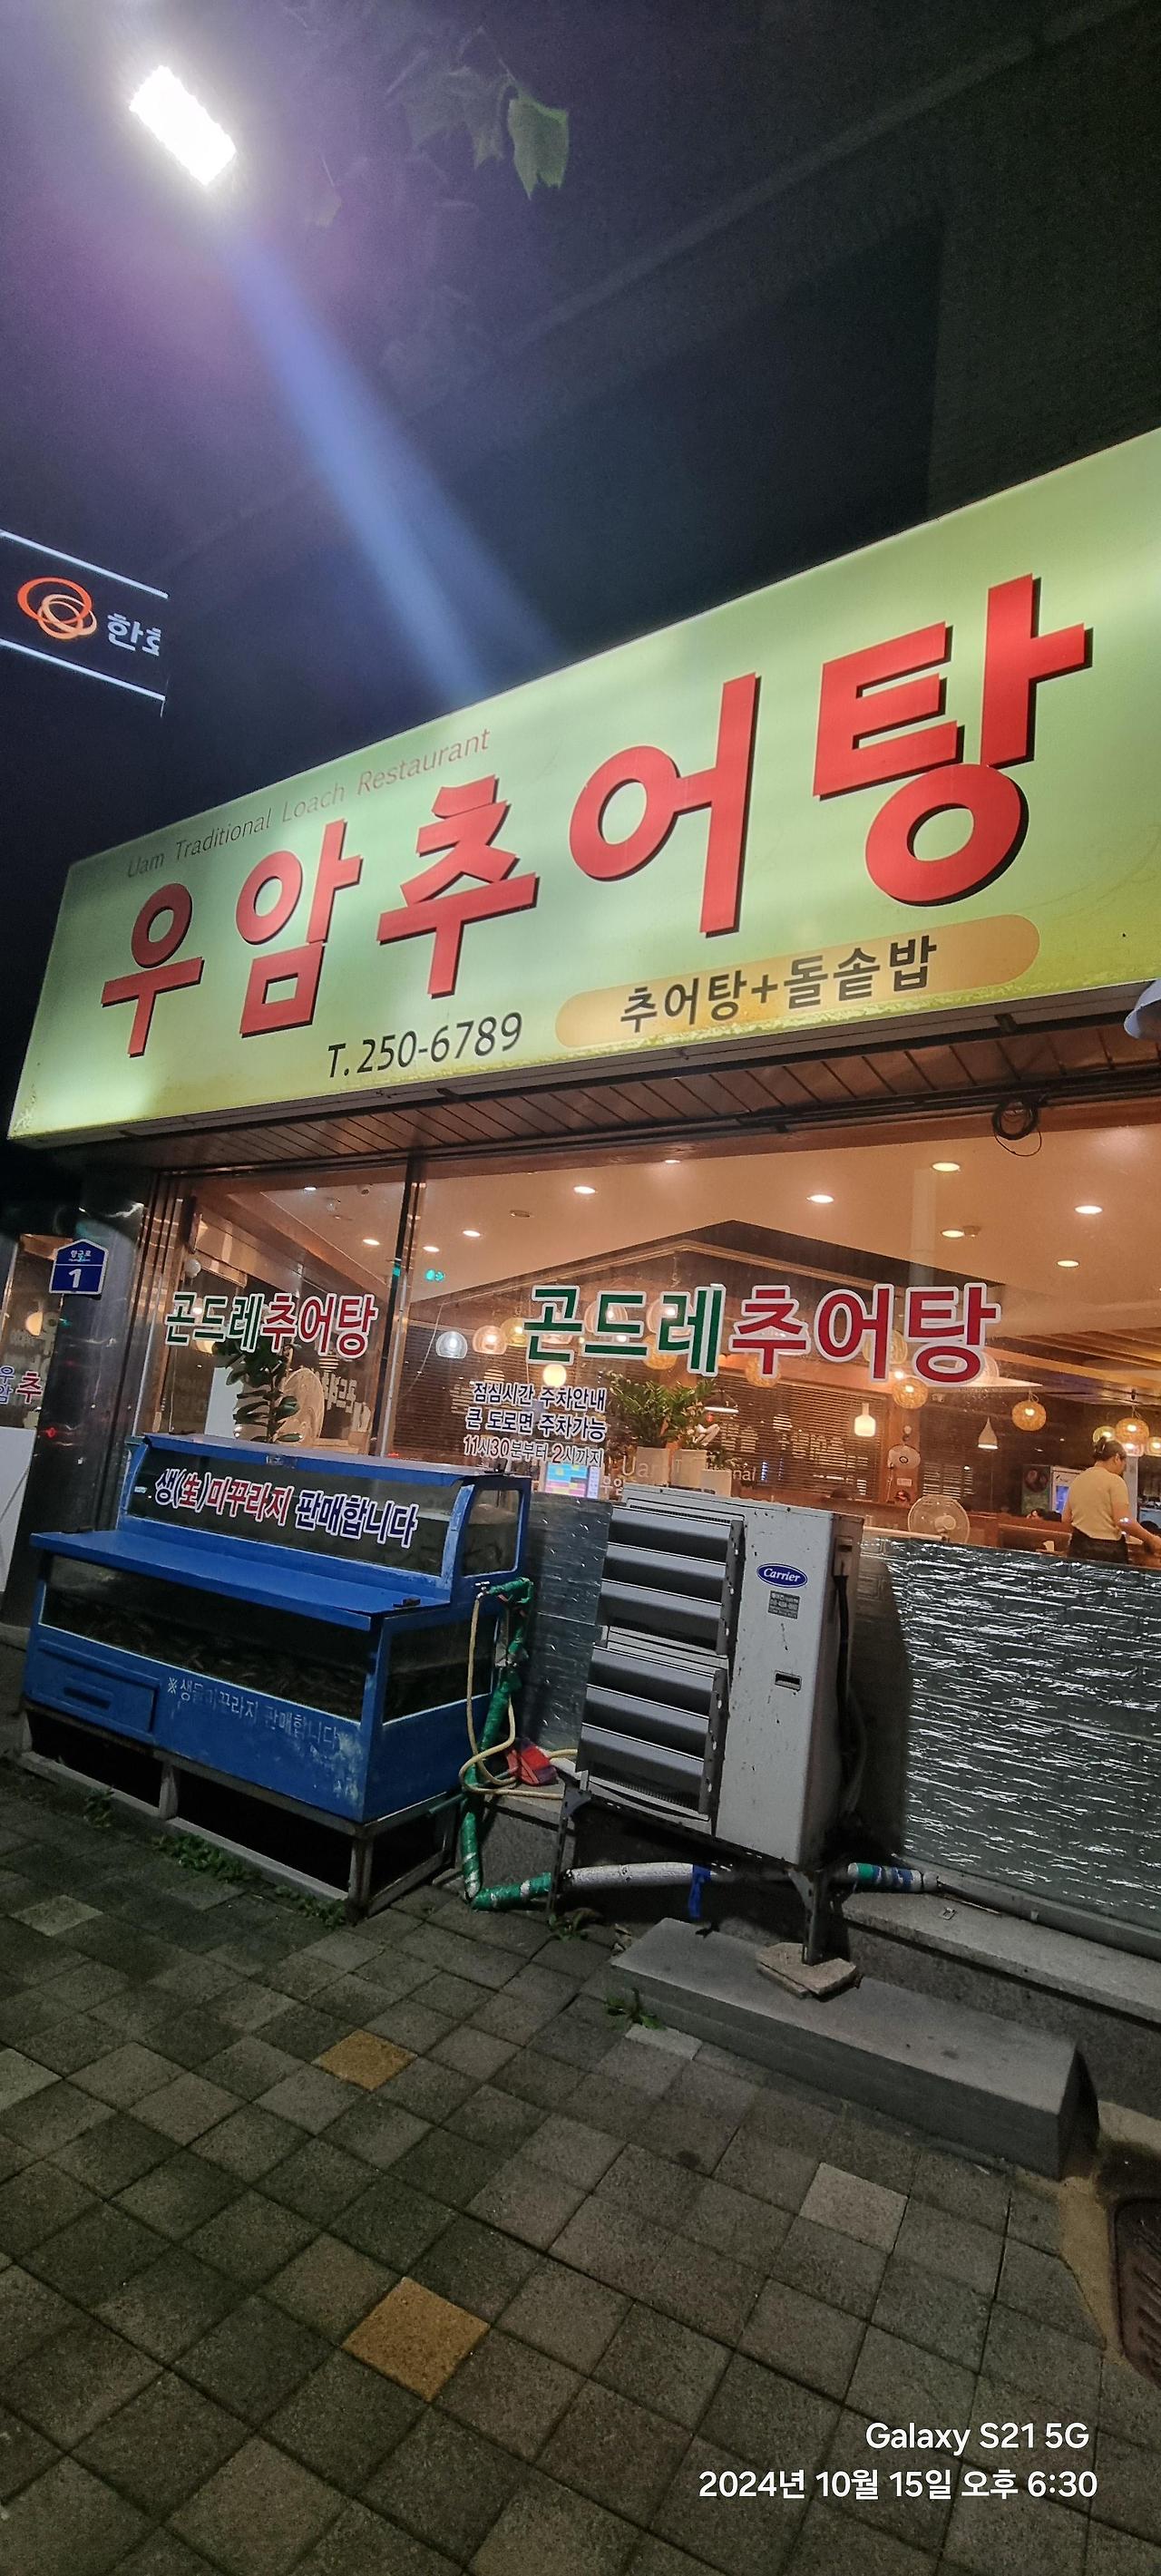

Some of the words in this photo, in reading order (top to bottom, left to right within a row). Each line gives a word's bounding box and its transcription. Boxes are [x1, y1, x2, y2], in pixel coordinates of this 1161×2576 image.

[101, 572, 1093, 1058] 우암추어탕
[127, 851, 164, 879] Uam
[175, 808, 272, 863] Traditional
[281, 782, 346, 823] Loach
[357, 727, 491, 796] Restaurant
[620, 934, 938, 1034] 추어탕+돌솥밥
[68, 1268, 82, 1288] 1
[165, 1291, 378, 1358] 곤드레추어탕
[523, 1281, 1001, 1388] 곤드레추어탕
[465, 1406, 483, 1431] 큰
[485, 1409, 534, 1435] 도로면
[538, 1413, 608, 1443] 주차가능
[473, 1382, 535, 1405] 점심시간
[539, 1385, 607, 1413] 주차안내
[463, 1434, 549, 1463] 11시30분부터
[551, 1442, 604, 1468] 2시까지
[155, 1468, 295, 1527] 생(生)미꾸라지
[295, 1490, 418, 1548] 판매합니다
[763, 1567, 800, 1583] Carrier
